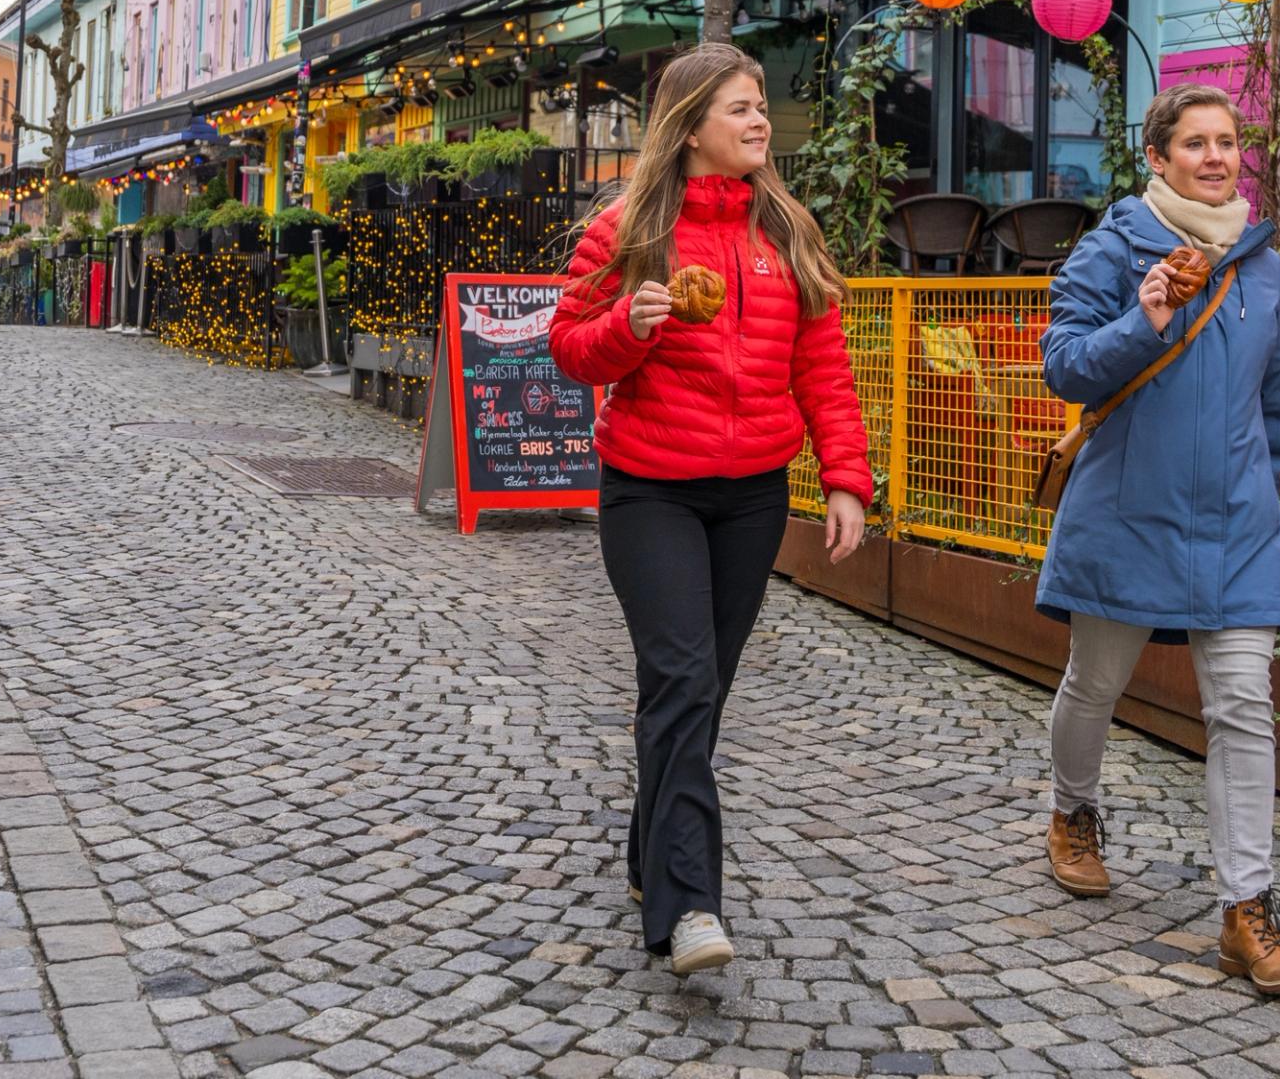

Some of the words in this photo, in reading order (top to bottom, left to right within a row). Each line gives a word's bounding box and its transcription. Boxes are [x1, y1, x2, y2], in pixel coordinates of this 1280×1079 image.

[492, 304, 523, 318] TIL
[475, 364, 520, 380] BARISTA
[525, 364, 560, 380] KAFFE
[473, 385, 501, 399] MAT
[550, 384, 583, 397] Byens
[482, 400, 495, 414] og
[558, 397, 583, 406] beste
[478, 410, 524, 427] SNACKS
[528, 423, 551, 437] Kaker
[479, 443, 514, 456] LOKALE
[520, 440, 554, 455] BRUS
[564, 438, 590, 454] JUS
[550, 465, 559, 474] og
